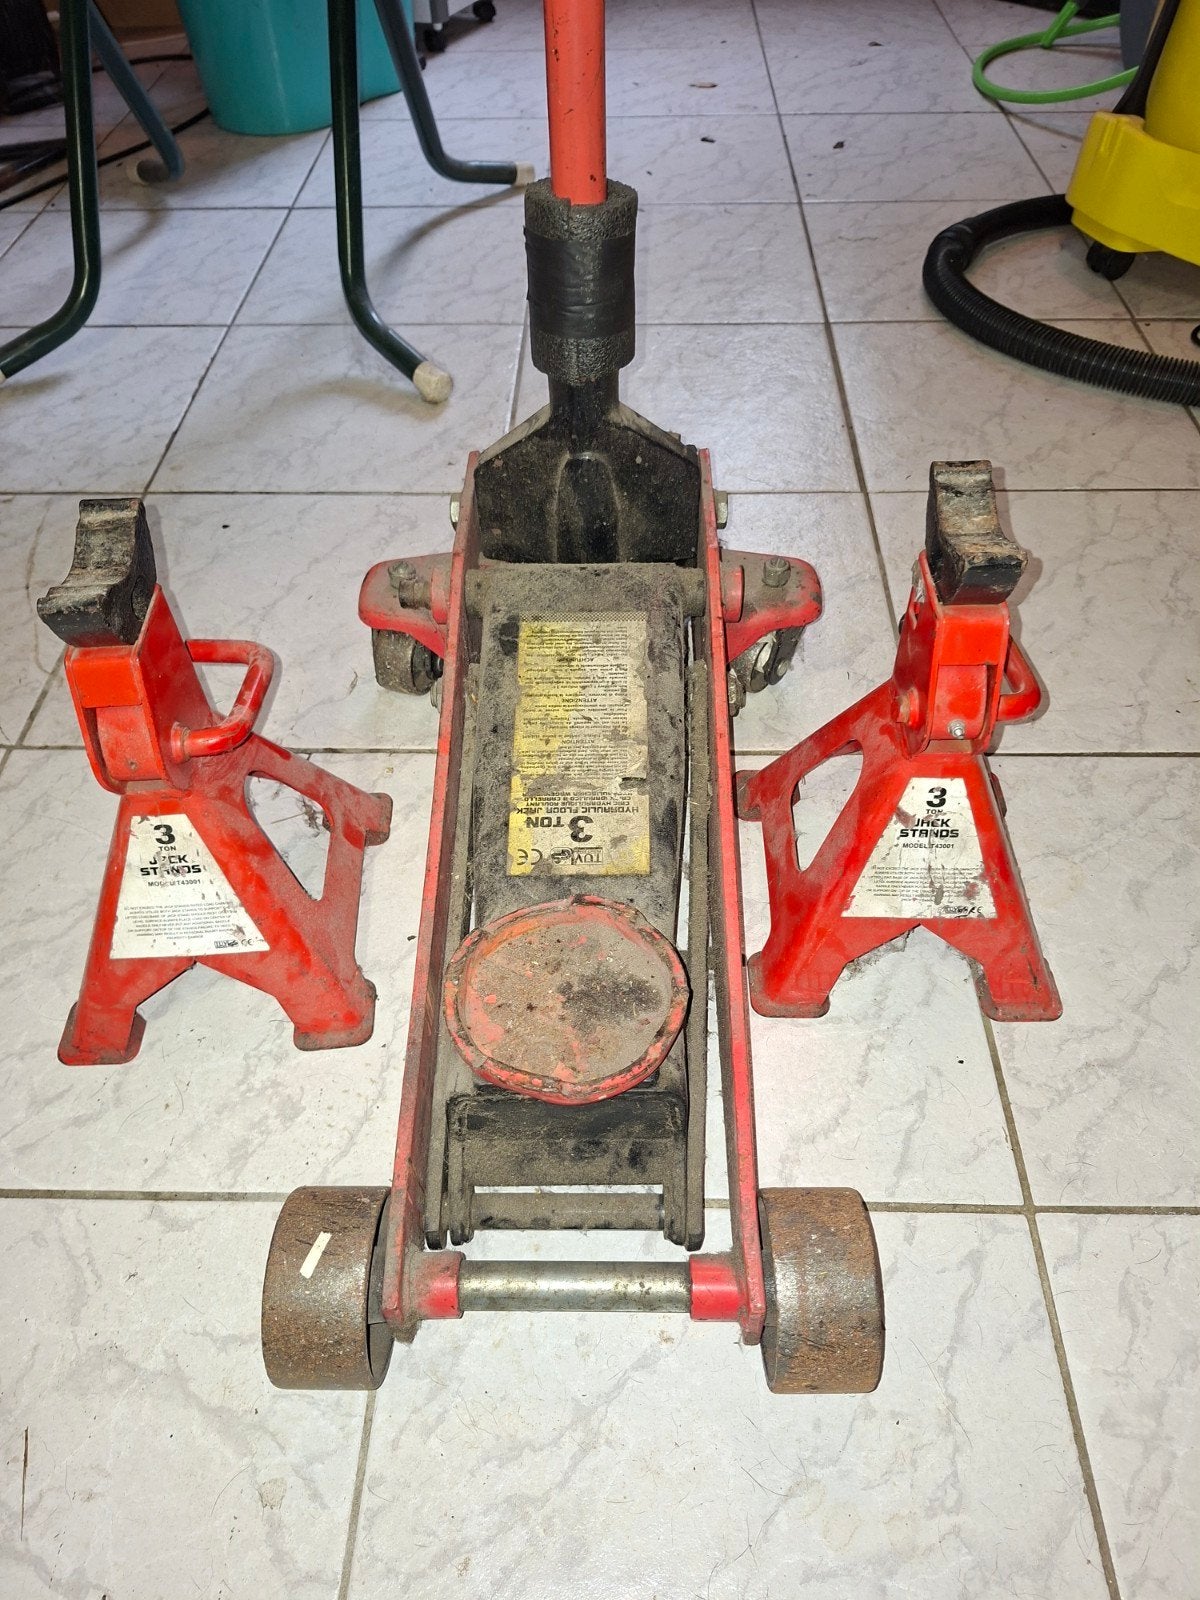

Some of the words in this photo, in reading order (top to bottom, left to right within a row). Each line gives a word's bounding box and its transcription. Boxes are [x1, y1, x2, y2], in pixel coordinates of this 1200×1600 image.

[926, 786, 947, 808] 3
[516, 807, 544, 815] JACK
[546, 806, 579, 814] FLOOR
[581, 806, 639, 814] HYDRAULIC
[525, 816, 565, 829] TON
[914, 818, 951, 828] JACK
[153, 824, 176, 845] 3
[567, 816, 595, 843] 3
[899, 828, 960, 838] STANDS
